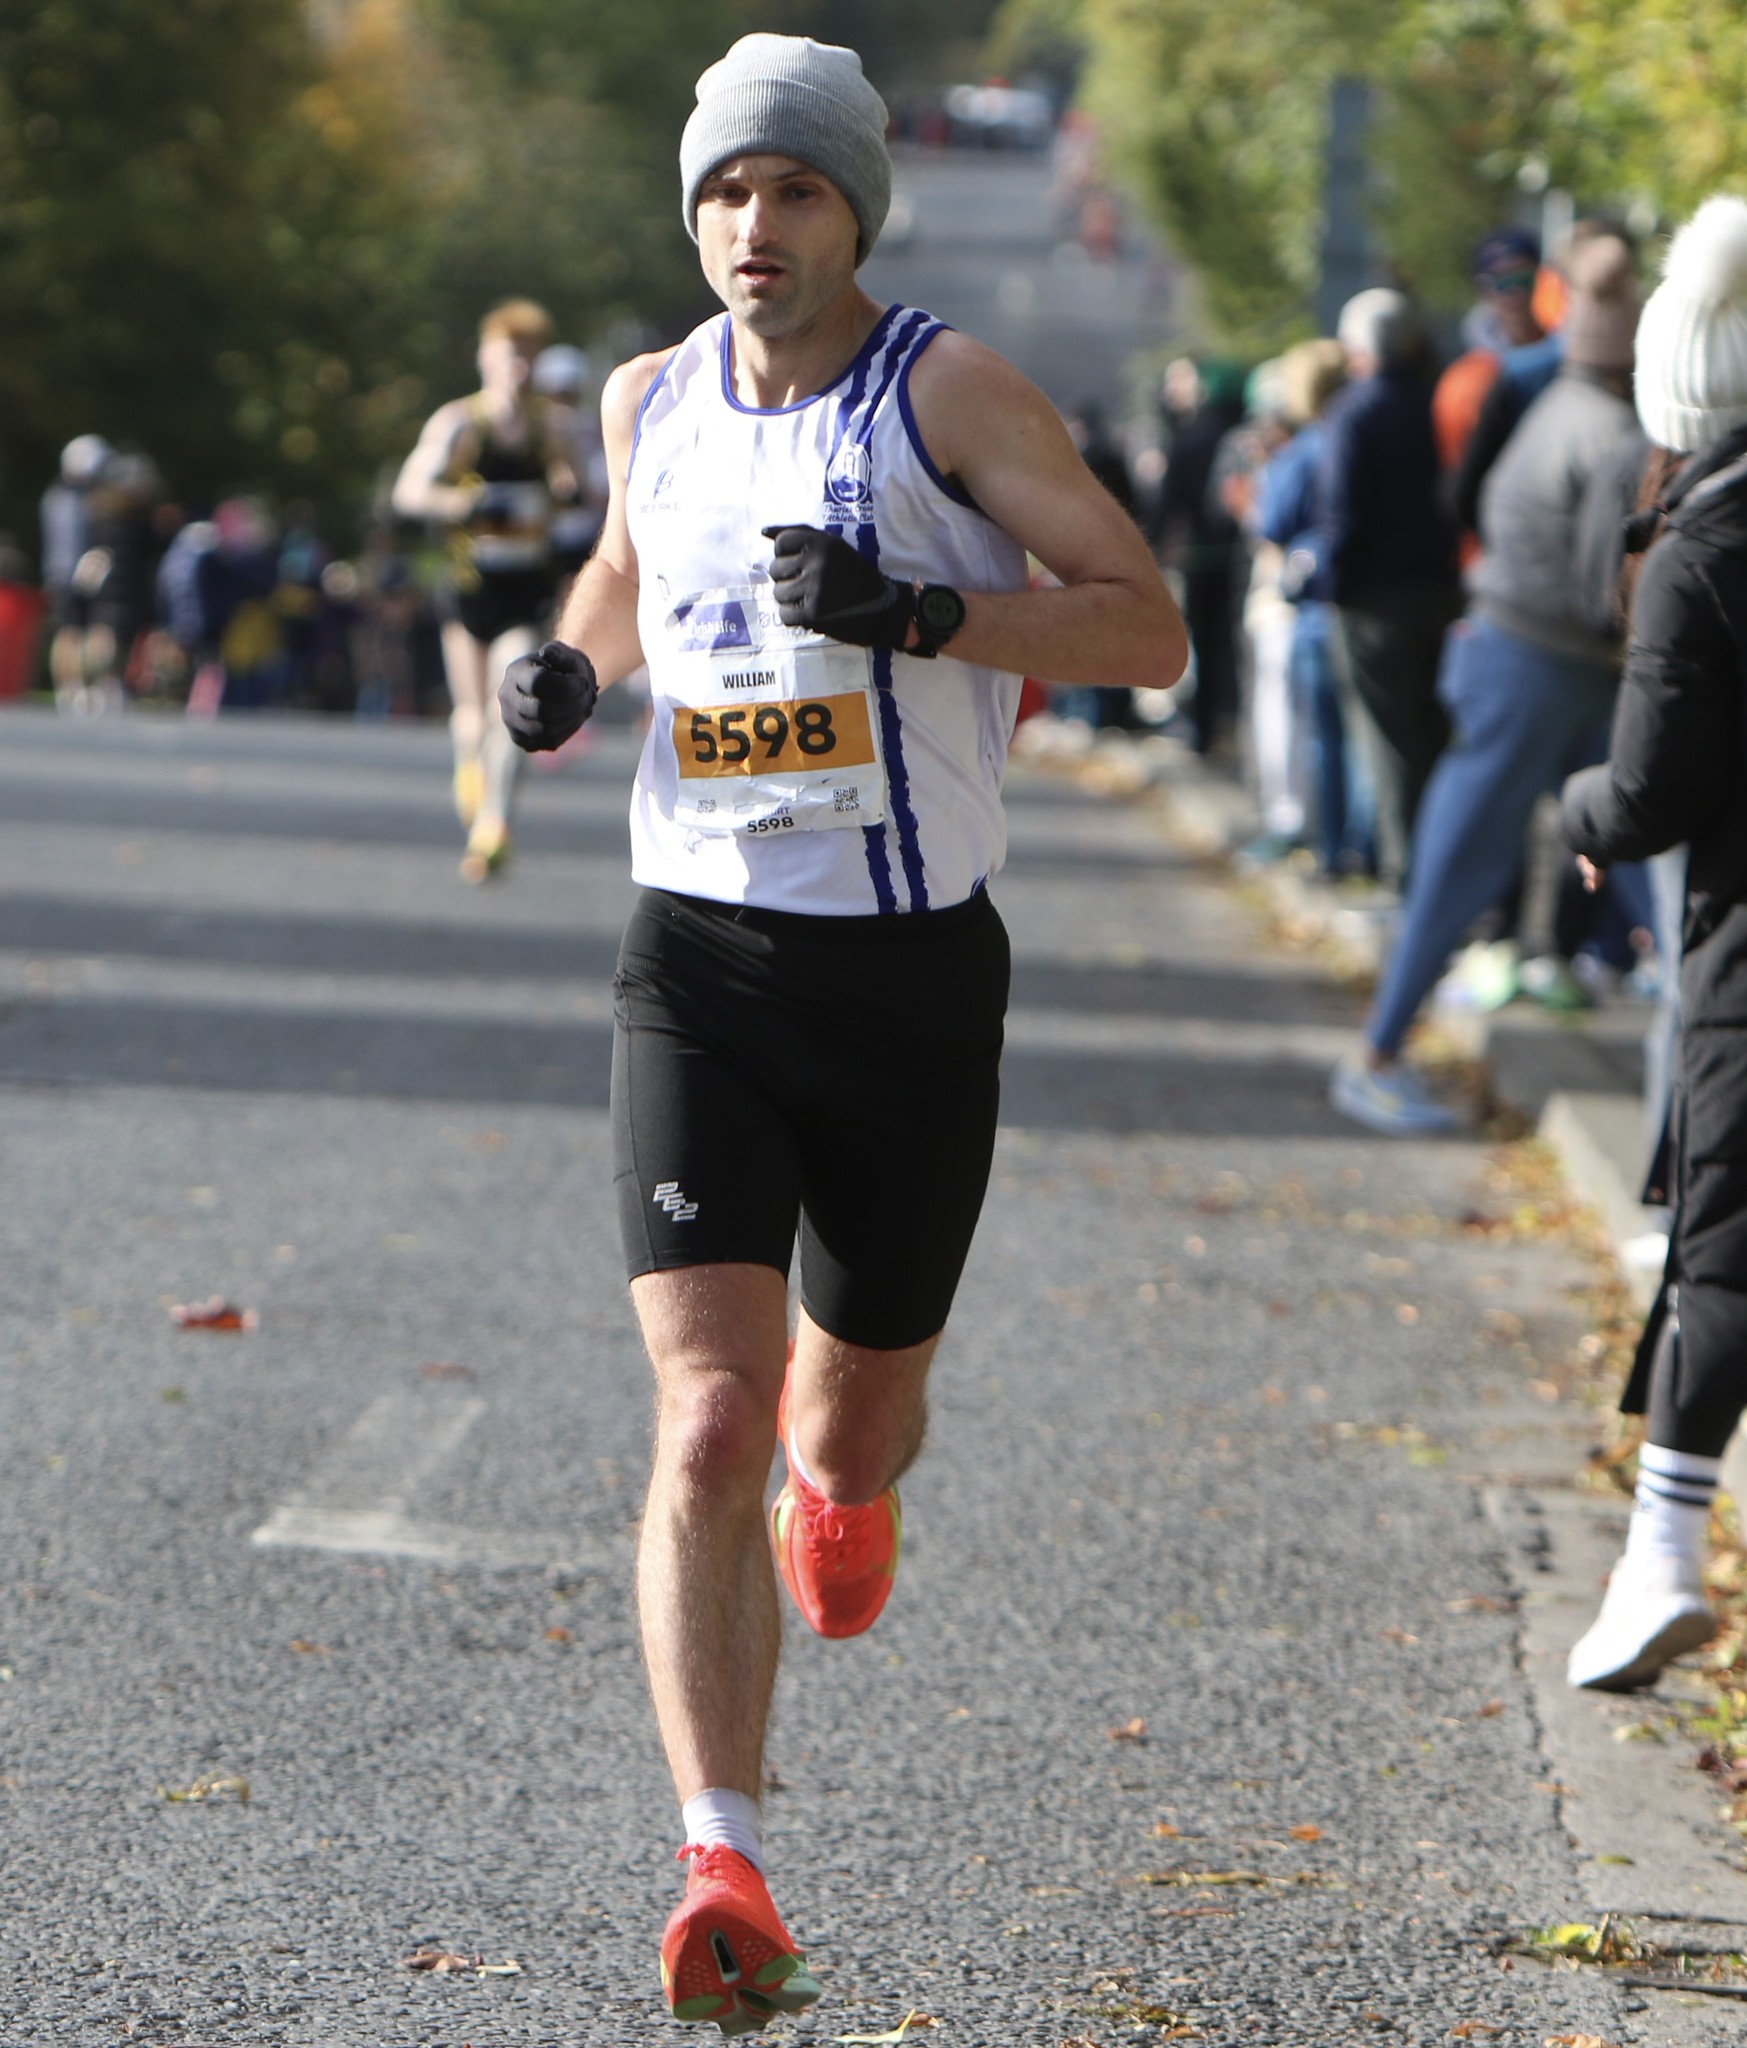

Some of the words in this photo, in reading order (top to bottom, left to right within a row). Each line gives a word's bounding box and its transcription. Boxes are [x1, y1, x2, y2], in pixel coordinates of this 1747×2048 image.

[825, 513, 857, 522] Athletic
[859, 512, 874, 522] Club
[714, 619, 737, 635] Life
[722, 671, 776, 689] WILLIAM
[690, 703, 837, 763] 5598
[747, 816, 794, 833] 5598
